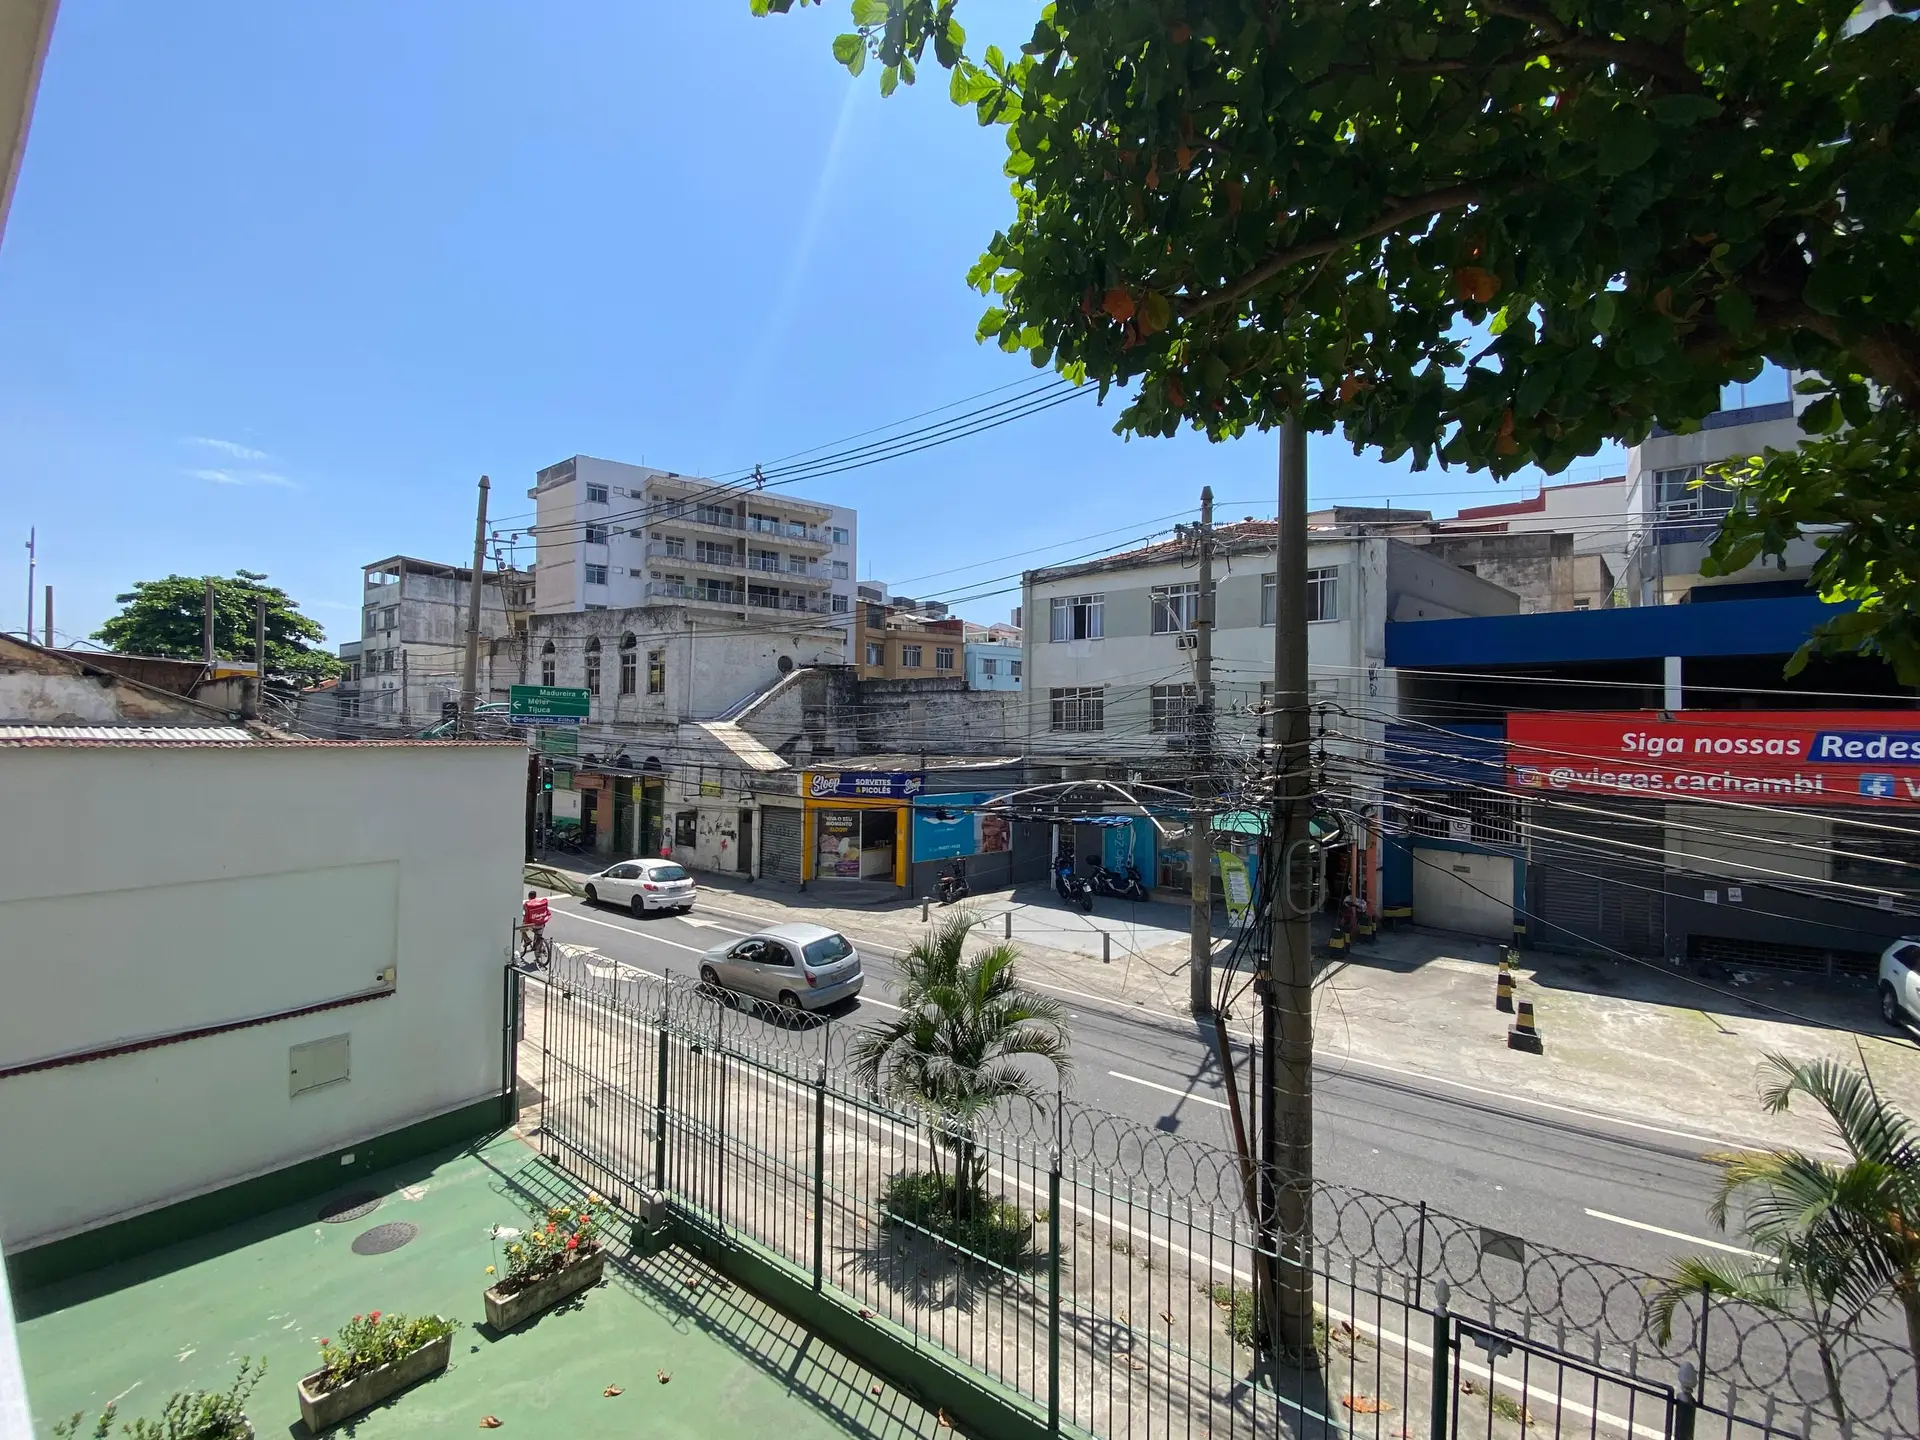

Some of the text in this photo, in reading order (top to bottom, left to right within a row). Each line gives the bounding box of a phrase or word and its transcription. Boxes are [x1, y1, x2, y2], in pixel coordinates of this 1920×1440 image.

[540, 689, 576, 697] Madureira
[1621, 733, 1684, 756] Siga
[1694, 738, 1801, 755] nossas
[810, 774, 840, 796] Sloop
[862, 786, 891, 794] PICOLÉS
[904, 778, 921, 794] Sloop
